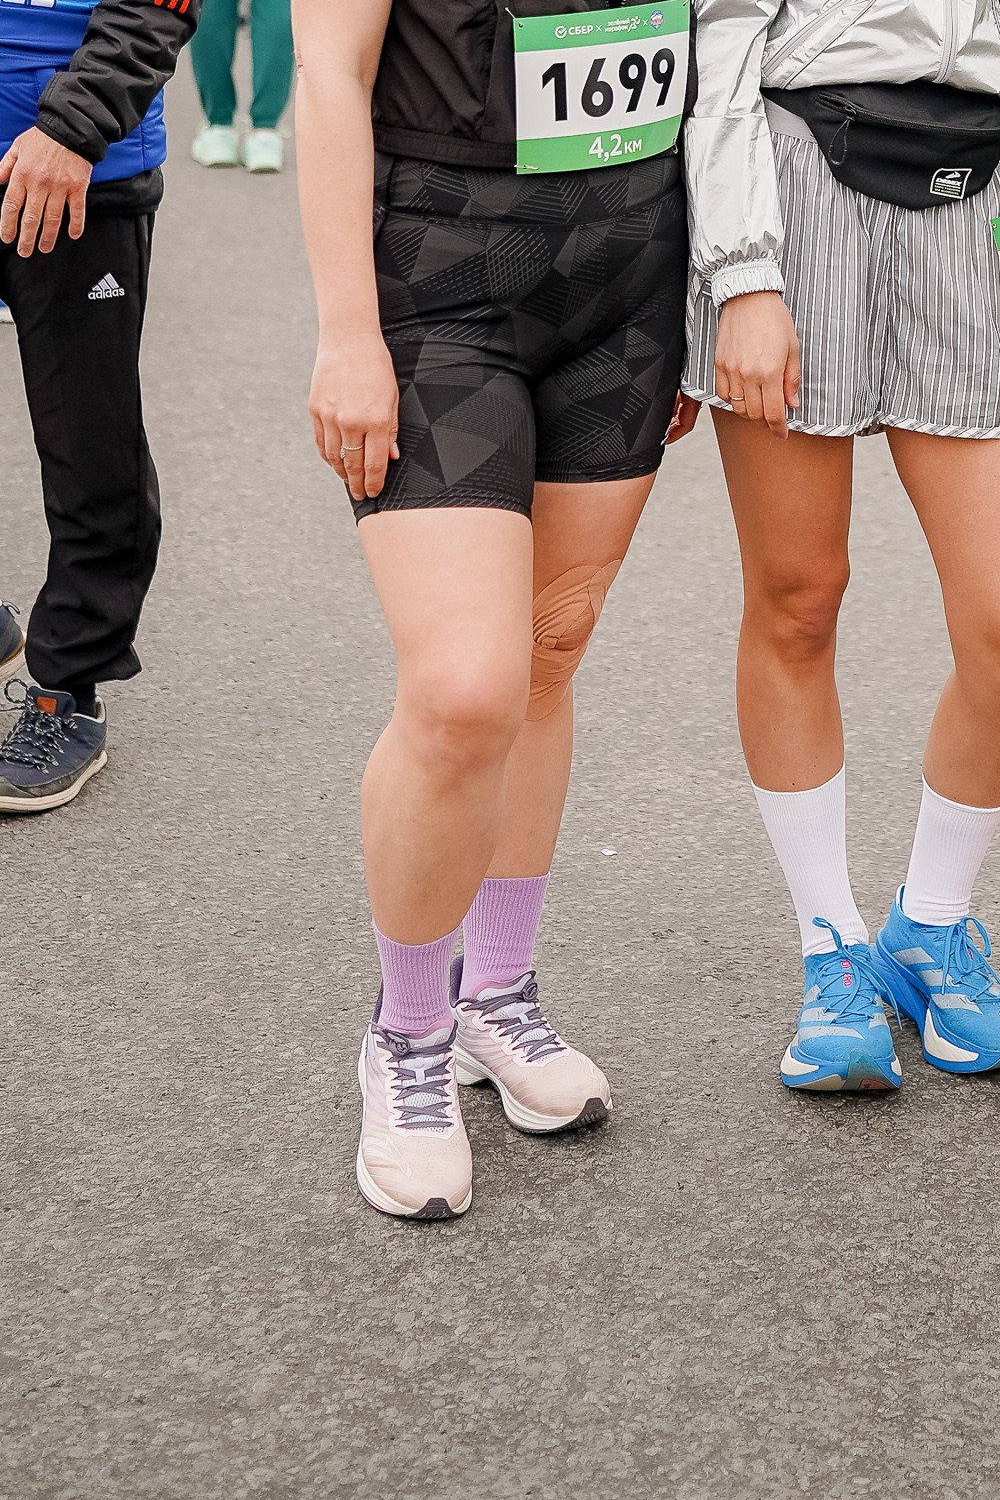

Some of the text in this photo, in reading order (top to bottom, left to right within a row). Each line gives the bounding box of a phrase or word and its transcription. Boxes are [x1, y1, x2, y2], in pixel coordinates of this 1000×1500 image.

[568, 24, 594, 36] СБЕР
[541, 48, 676, 122] 1699
[588, 133, 623, 162] 4,2
[88, 288, 125, 300] adidas
